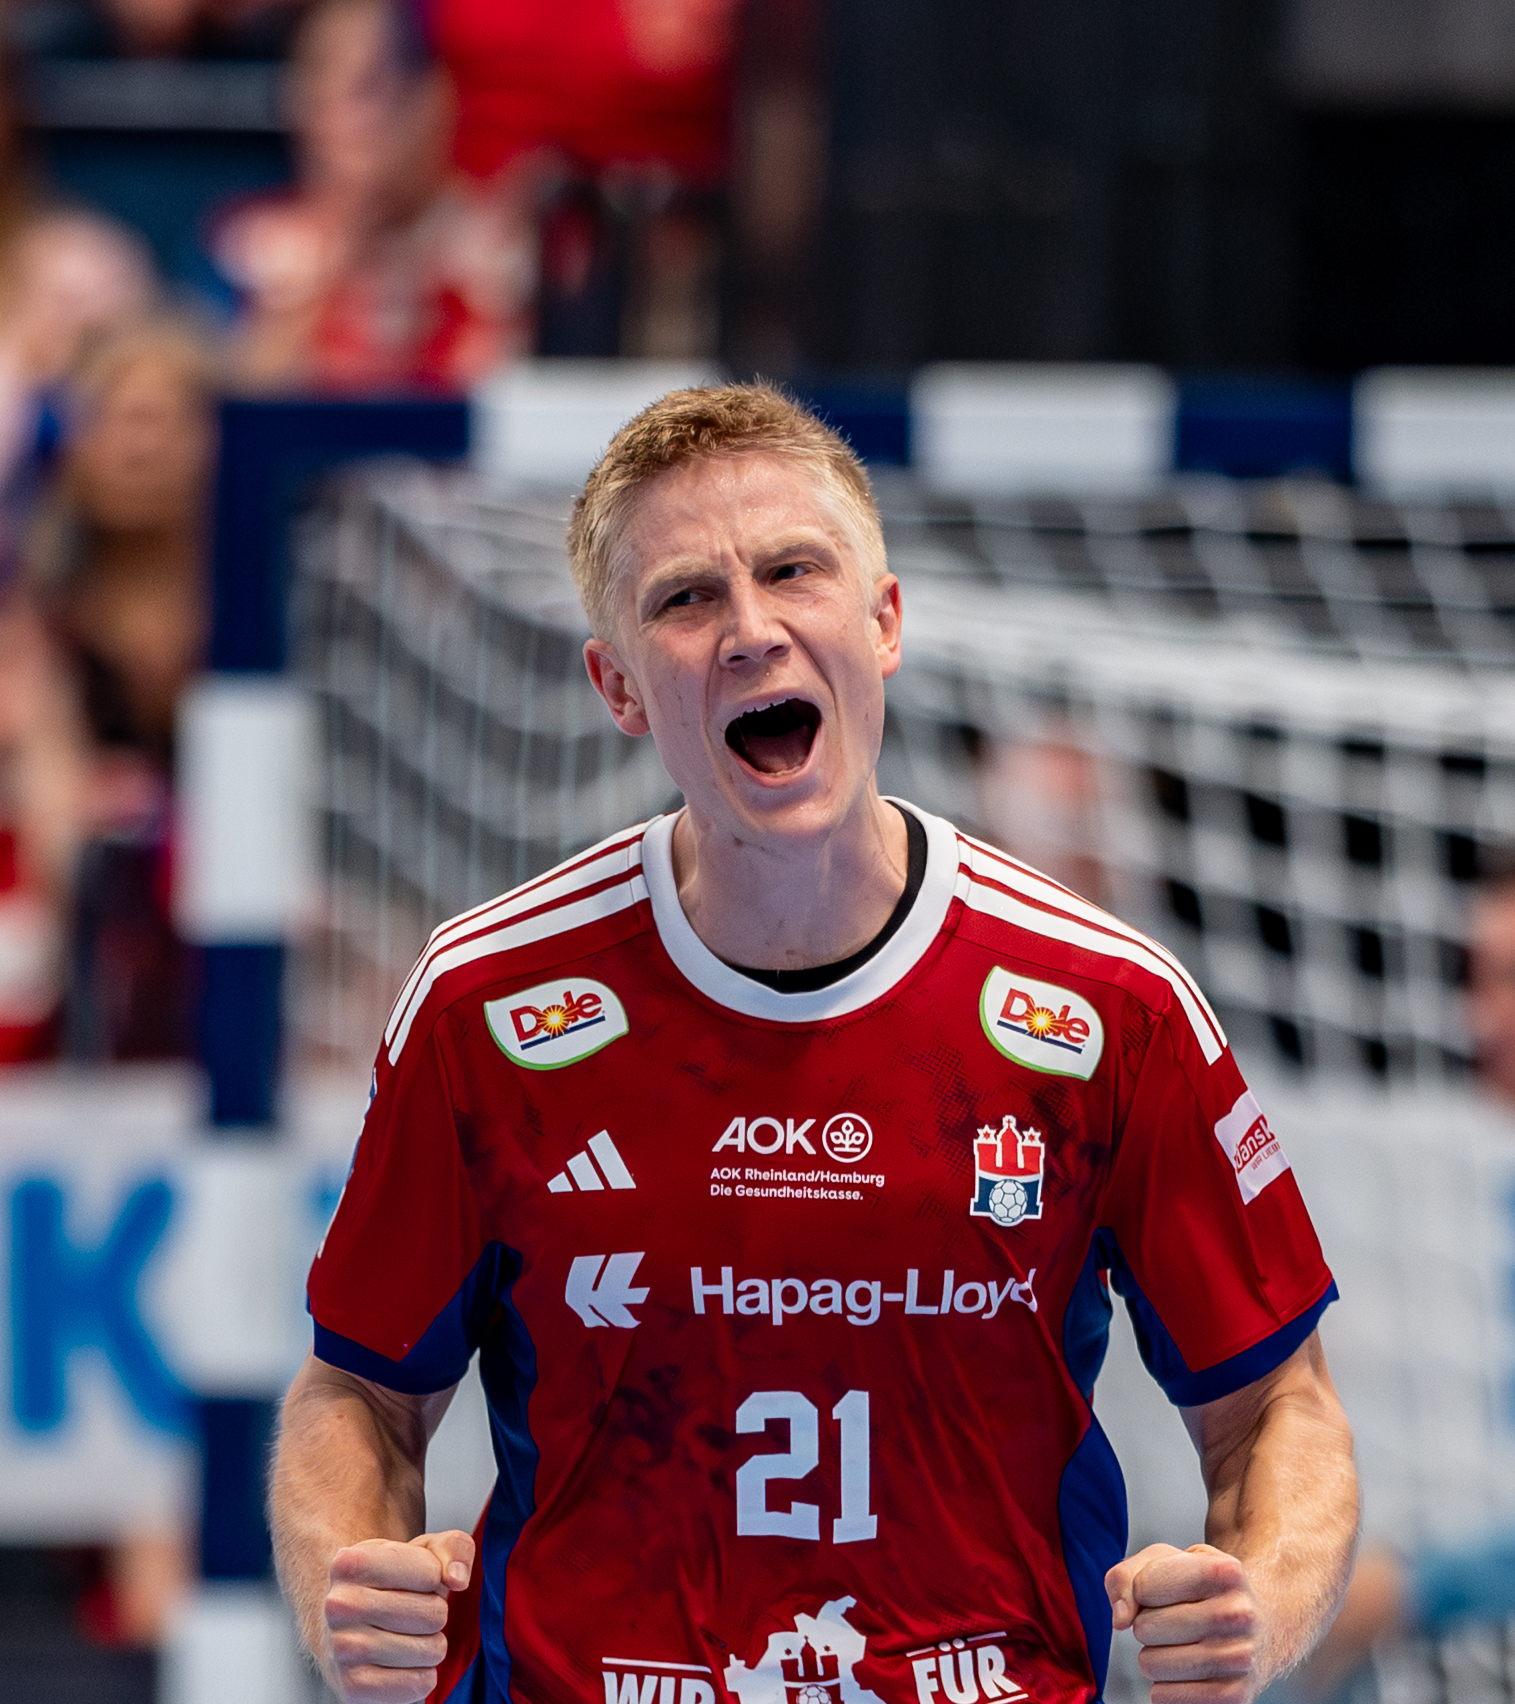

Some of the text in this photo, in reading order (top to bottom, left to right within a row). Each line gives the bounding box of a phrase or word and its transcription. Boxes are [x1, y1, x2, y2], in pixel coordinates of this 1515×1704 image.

[509, 990, 602, 1042] Dole
[1000, 988, 1090, 1044] Dole
[711, 1116, 817, 1155] AOK
[710, 1167, 885, 1188] AOK Rheinland/Hamburg
[710, 1184, 864, 1201] Die Gesundheitskasse.
[690, 1266, 1037, 1326] Hapag-Lloyd
[736, 1389, 877, 1543] 21
